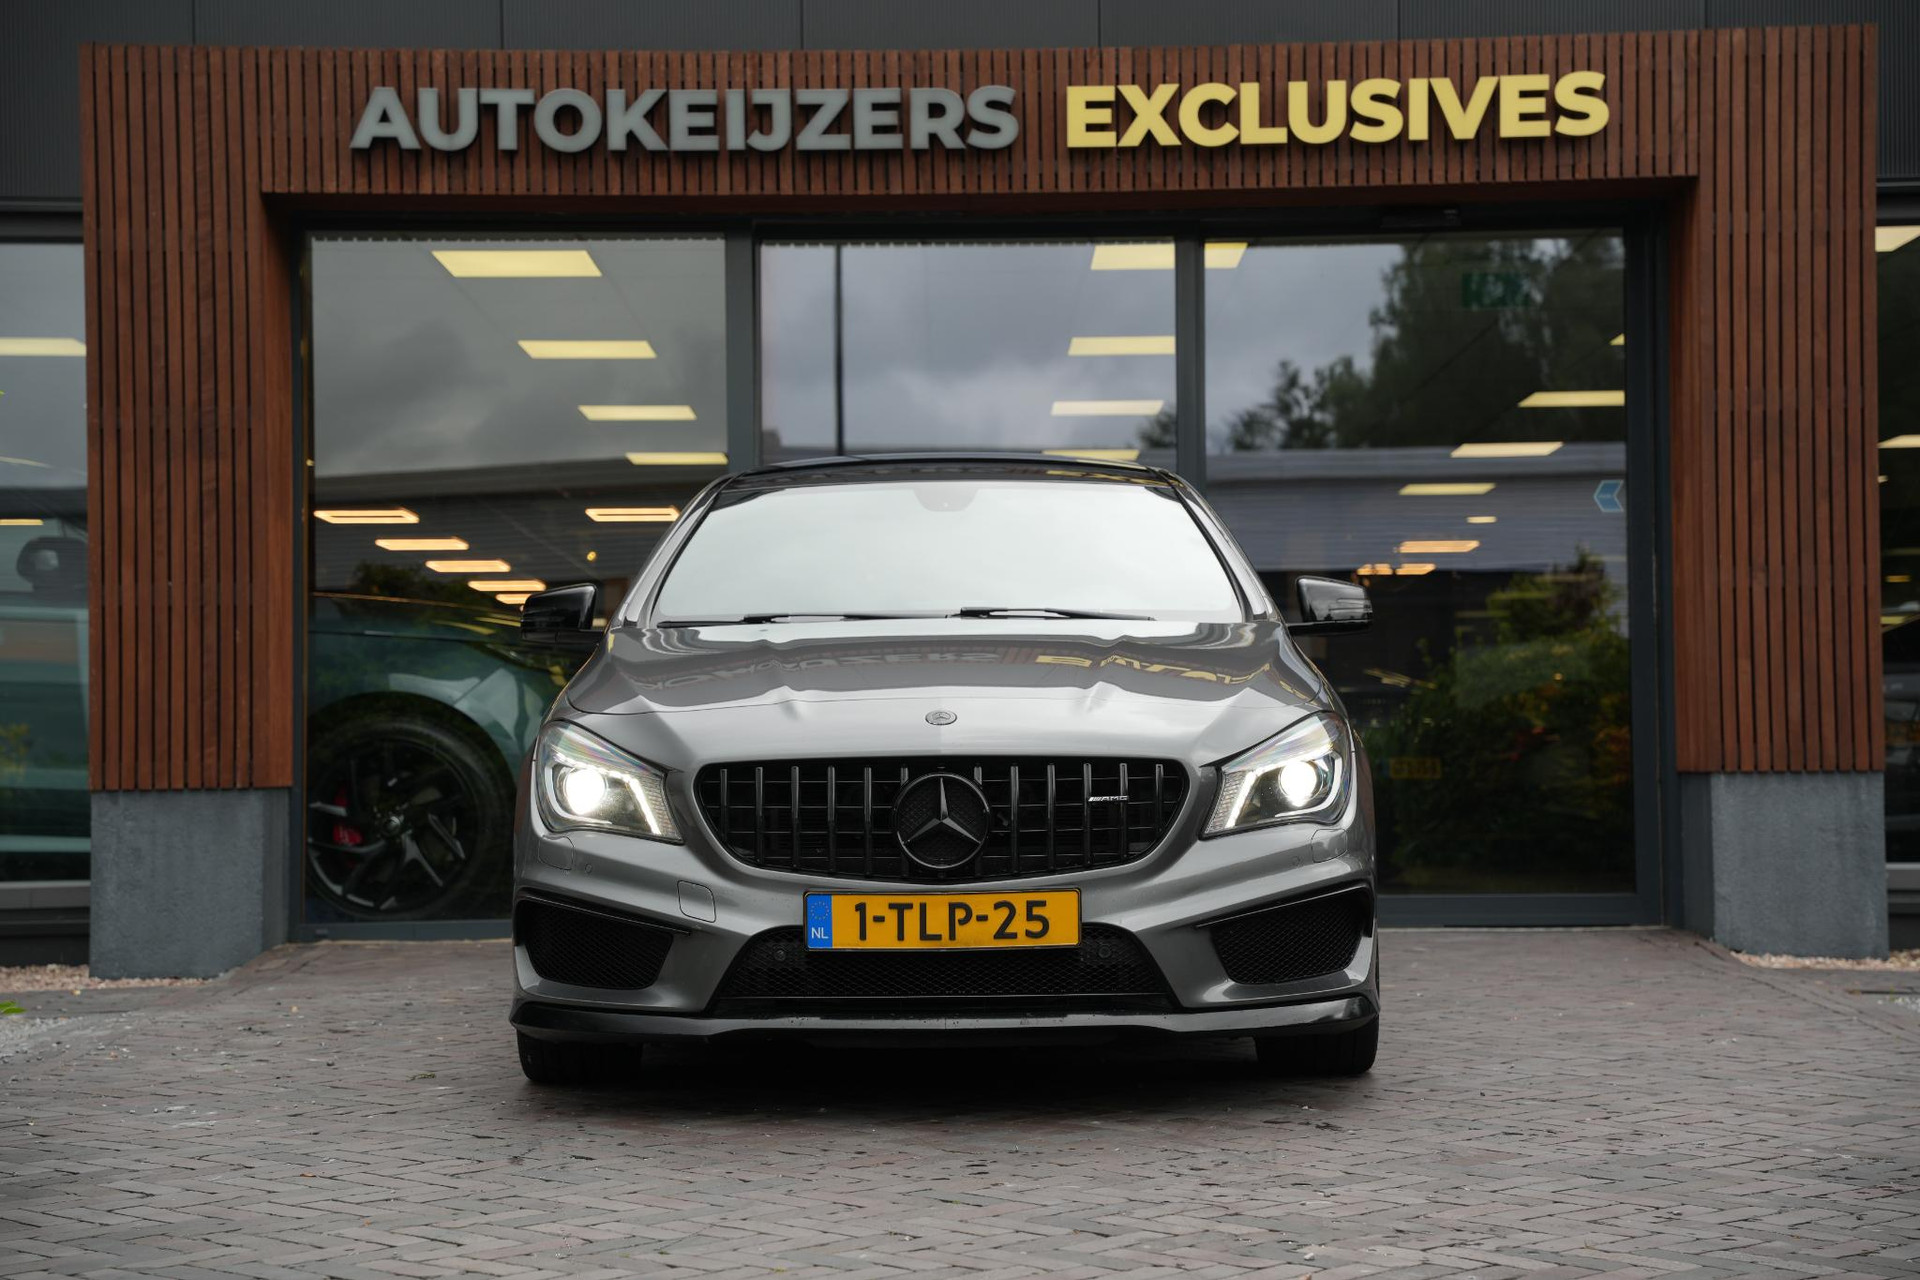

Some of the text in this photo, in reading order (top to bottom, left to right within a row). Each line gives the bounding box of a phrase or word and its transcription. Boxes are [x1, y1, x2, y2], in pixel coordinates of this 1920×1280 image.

[350, 70, 1610, 153] AUTOKEIJZERS EXCLUSIVES
[811, 926, 829, 939] NL
[855, 900, 1050, 941] 1-TLP-25
